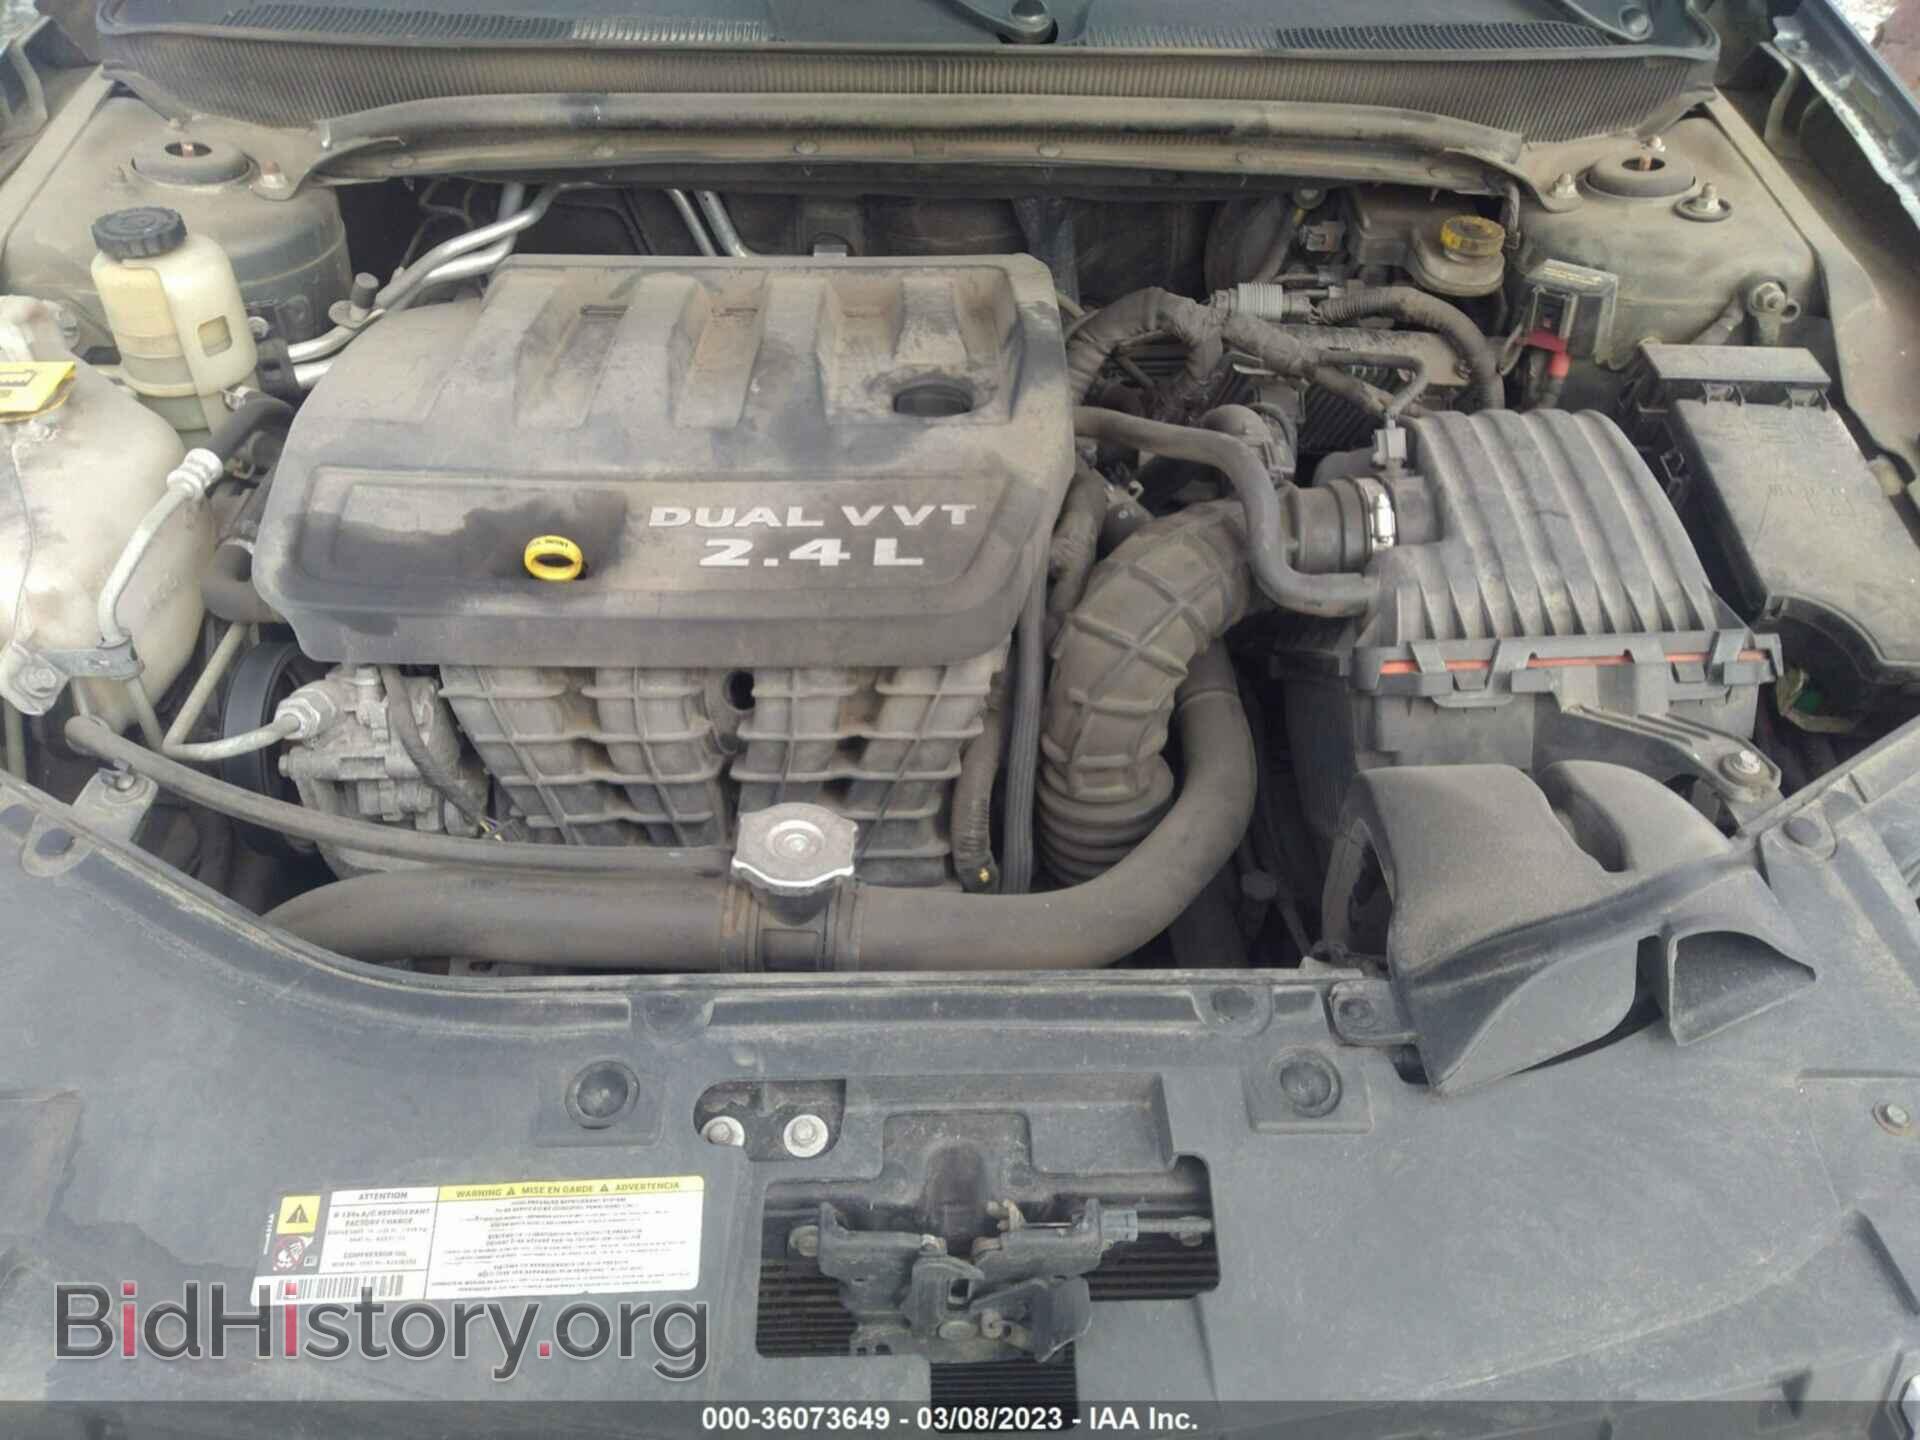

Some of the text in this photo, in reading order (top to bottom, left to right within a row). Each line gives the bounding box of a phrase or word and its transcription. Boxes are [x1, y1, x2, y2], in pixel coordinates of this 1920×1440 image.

[648, 504, 977, 528] DUAL VVT
[699, 538, 925, 567] 2.4 L
[358, 1191, 408, 1201] ATTENTION
[456, 1181, 680, 1198] WARNING MISE EN GARDE ADVERTENCIA
